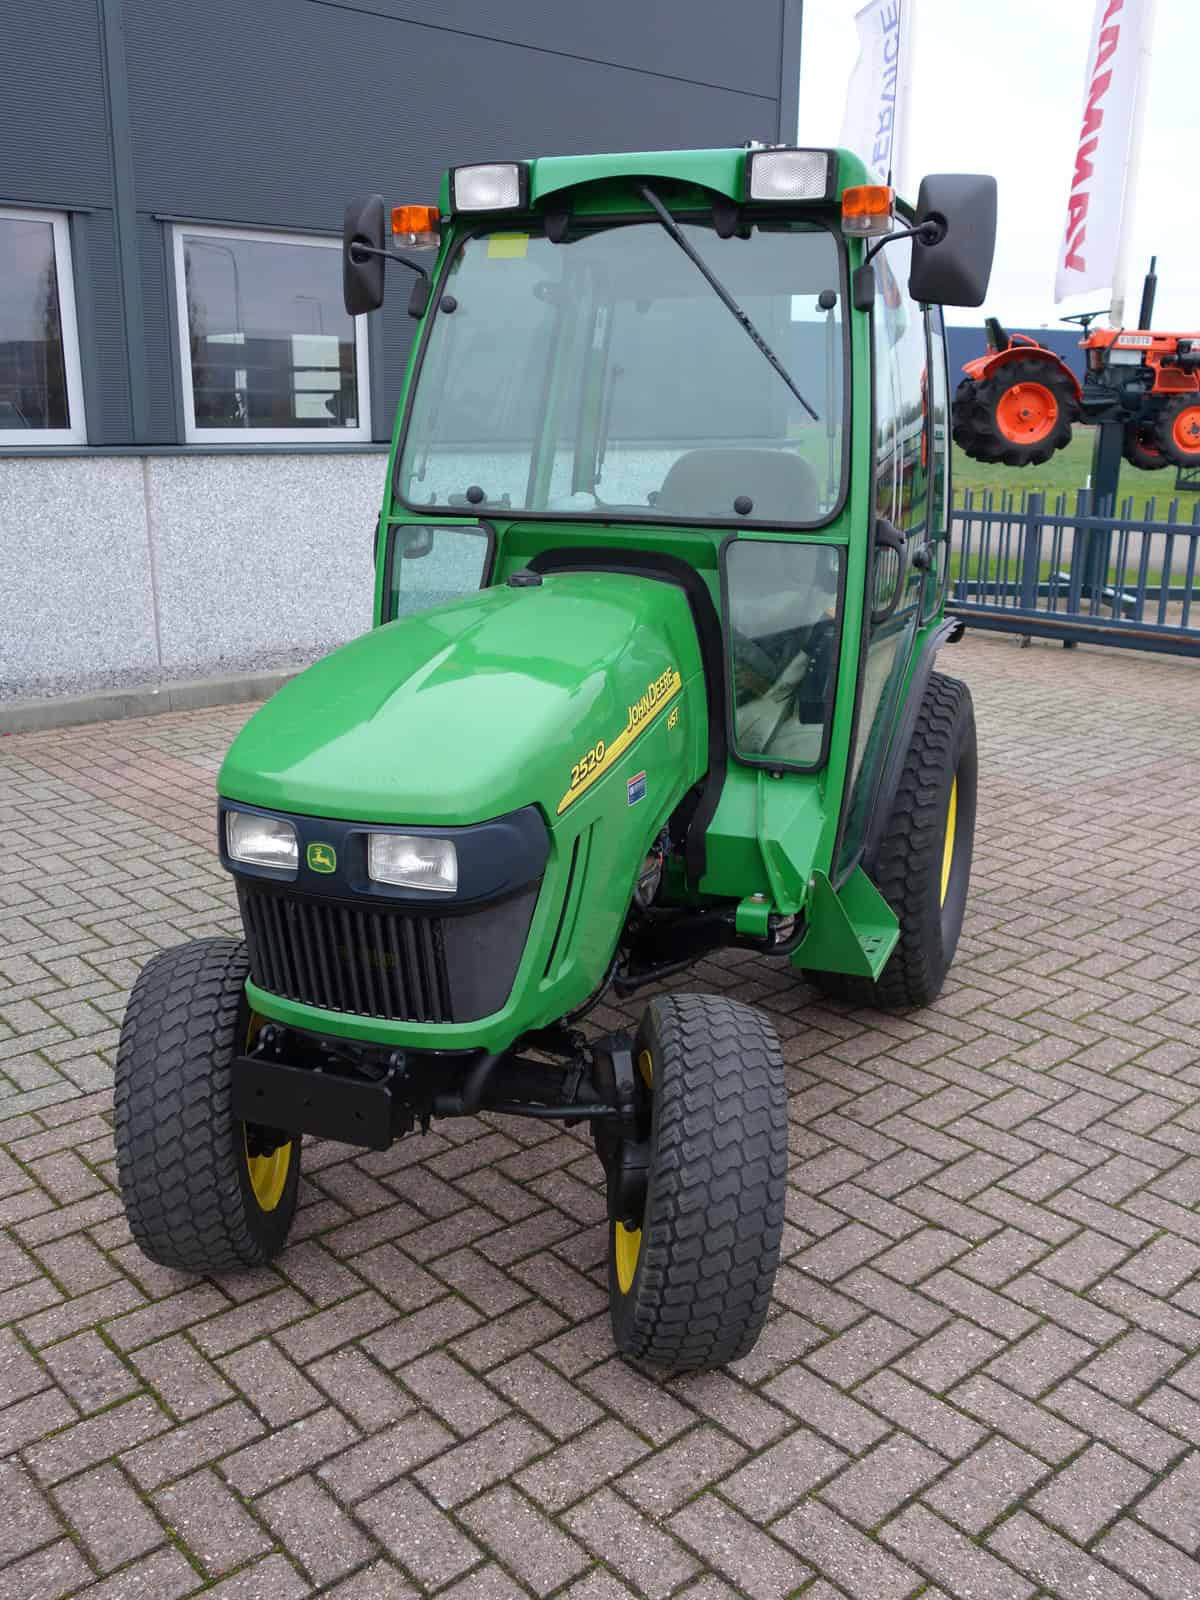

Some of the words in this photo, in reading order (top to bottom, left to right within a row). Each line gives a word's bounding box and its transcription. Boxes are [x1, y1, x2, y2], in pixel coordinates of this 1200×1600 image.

[627, 695, 652, 732] JOHN
[648, 666, 674, 706] DEERE
[666, 707, 679, 731] HST
[570, 740, 605, 789] 2520
